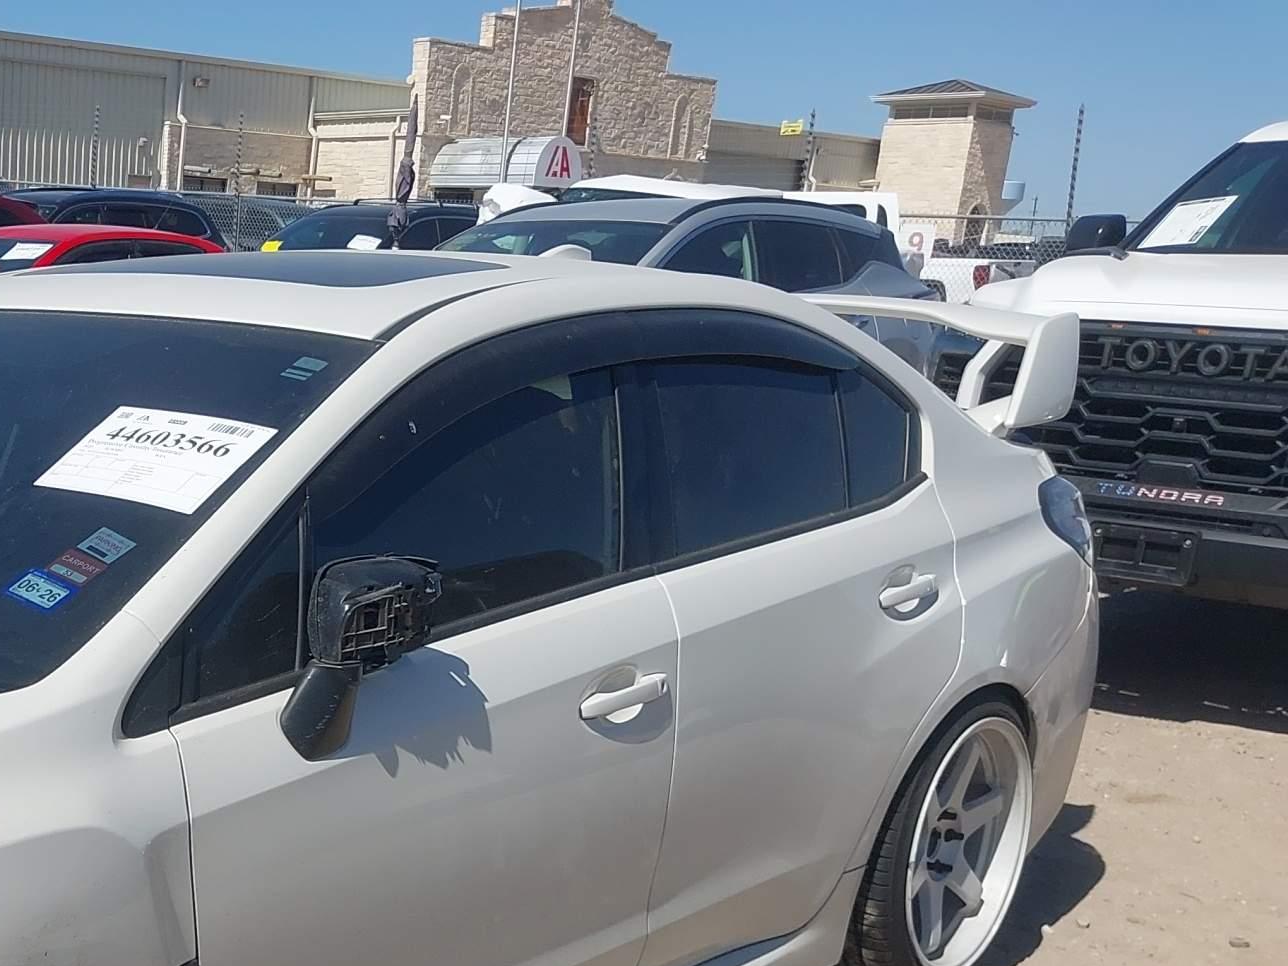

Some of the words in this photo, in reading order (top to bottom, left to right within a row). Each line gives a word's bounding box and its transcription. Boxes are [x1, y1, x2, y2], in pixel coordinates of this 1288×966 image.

[908, 231, 924, 251] 9
[1097, 336, 1288, 382] TOYOTA
[106, 426, 238, 457] 44603566
[1097, 482, 1225, 506] TUNDRA
[62, 554, 101, 575] CARPORT
